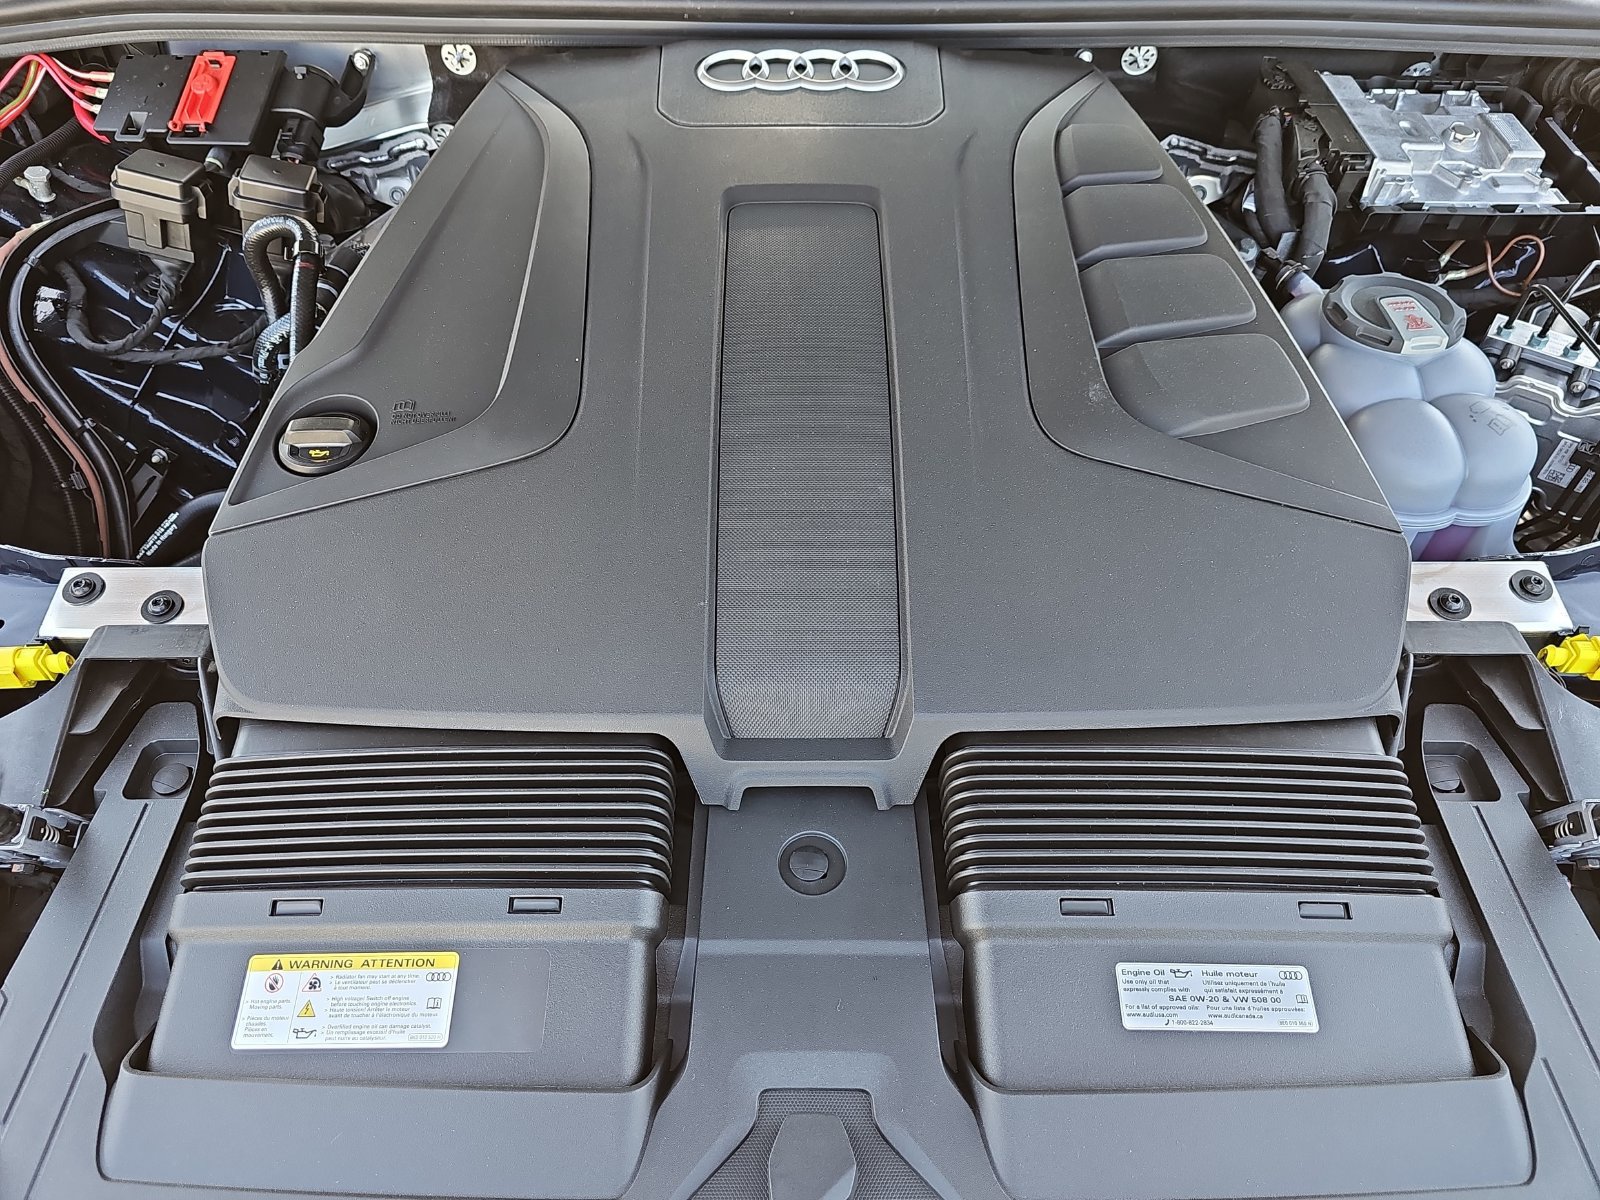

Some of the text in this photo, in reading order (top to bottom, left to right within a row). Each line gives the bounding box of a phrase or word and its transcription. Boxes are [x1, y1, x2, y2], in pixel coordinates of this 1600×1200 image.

[289, 958, 436, 969] WARNING ATTENTION
[1121, 968, 1151, 976] Engine
